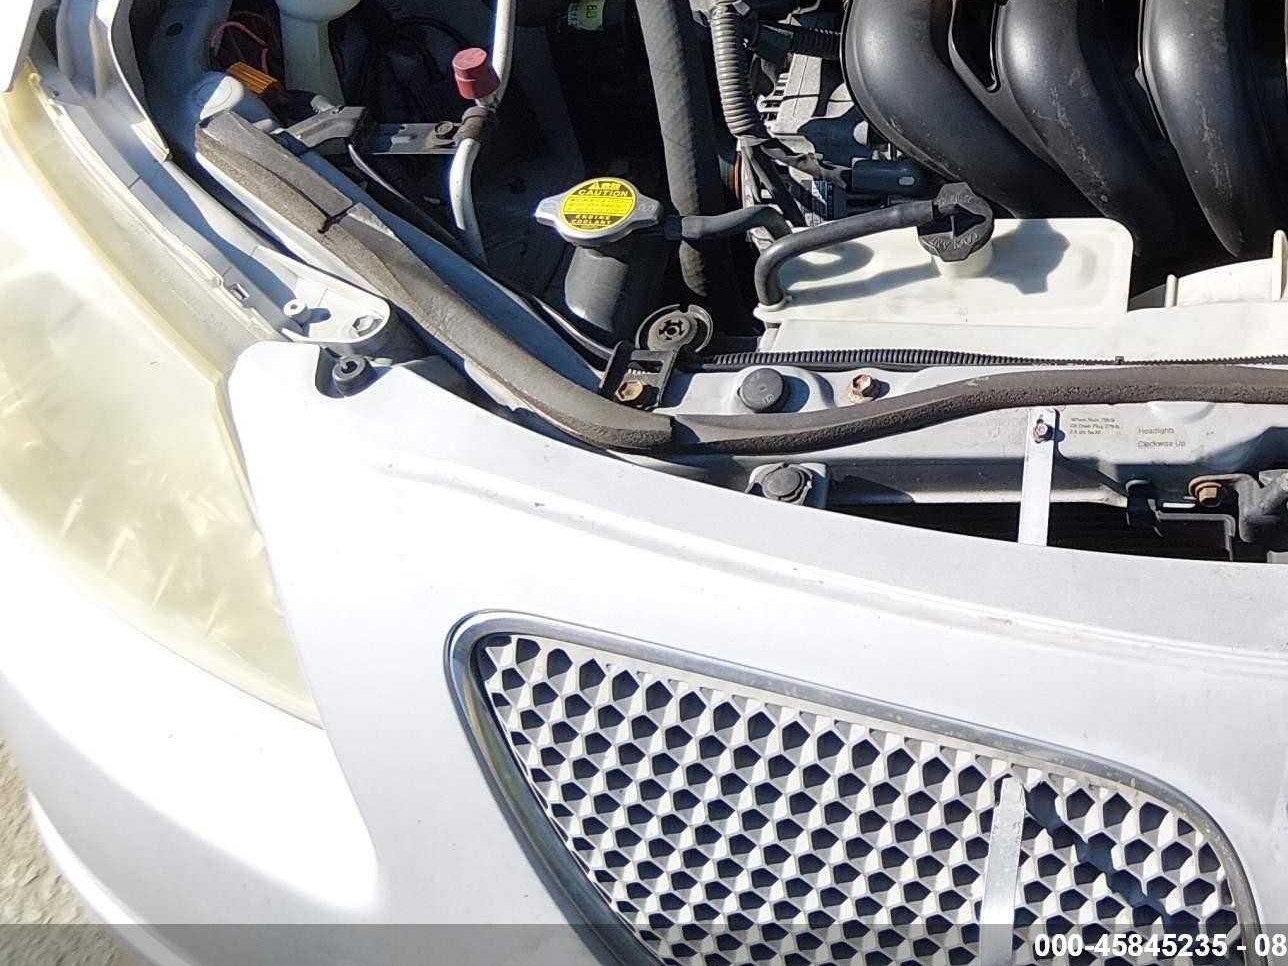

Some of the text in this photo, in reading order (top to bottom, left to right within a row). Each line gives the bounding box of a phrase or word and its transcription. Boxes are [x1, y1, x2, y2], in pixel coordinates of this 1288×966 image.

[578, 189, 629, 197] CAUTION
[1138, 427, 1175, 435] Headlights
[1138, 440, 1173, 448] Clockwise
